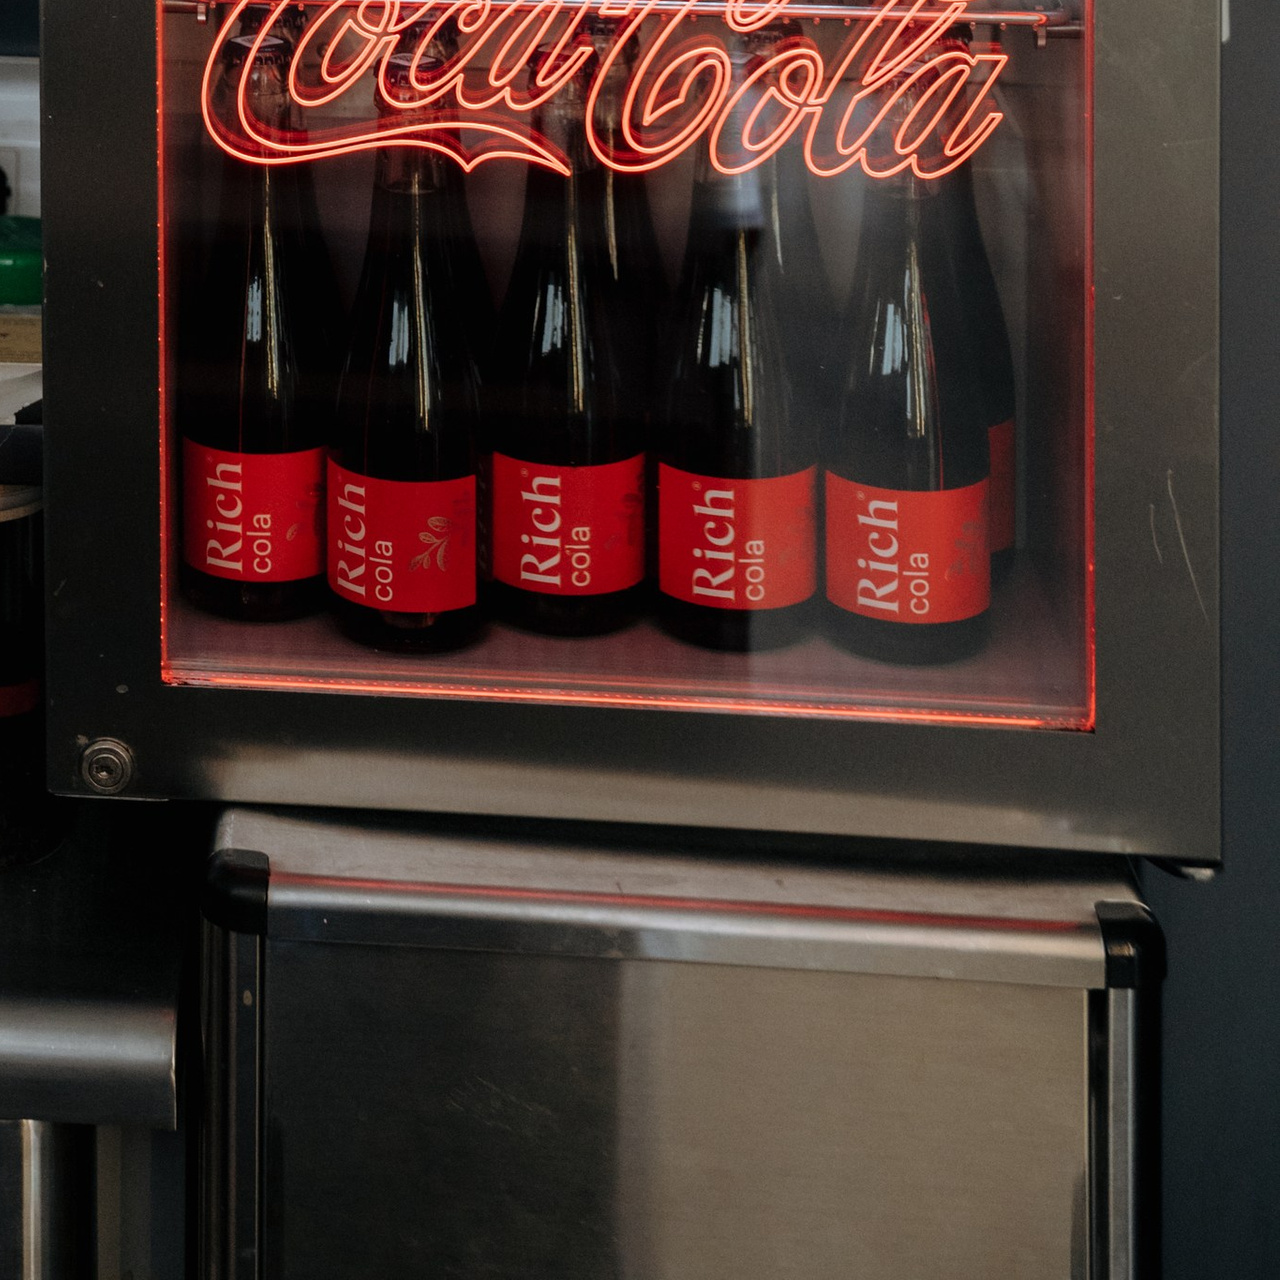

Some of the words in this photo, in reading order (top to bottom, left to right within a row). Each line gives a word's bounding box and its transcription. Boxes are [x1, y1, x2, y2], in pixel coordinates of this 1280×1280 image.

[206, 461, 243, 574] Rich
[246, 513, 271, 574] cola
[337, 482, 366, 599] Rich
[521, 474, 561, 588] Rich
[565, 526, 591, 587] cola
[692, 489, 735, 601] Rich
[857, 499, 899, 614] Rich
[369, 540, 393, 602] cola
[738, 540, 765, 601] cola
[903, 552, 929, 615] cola
